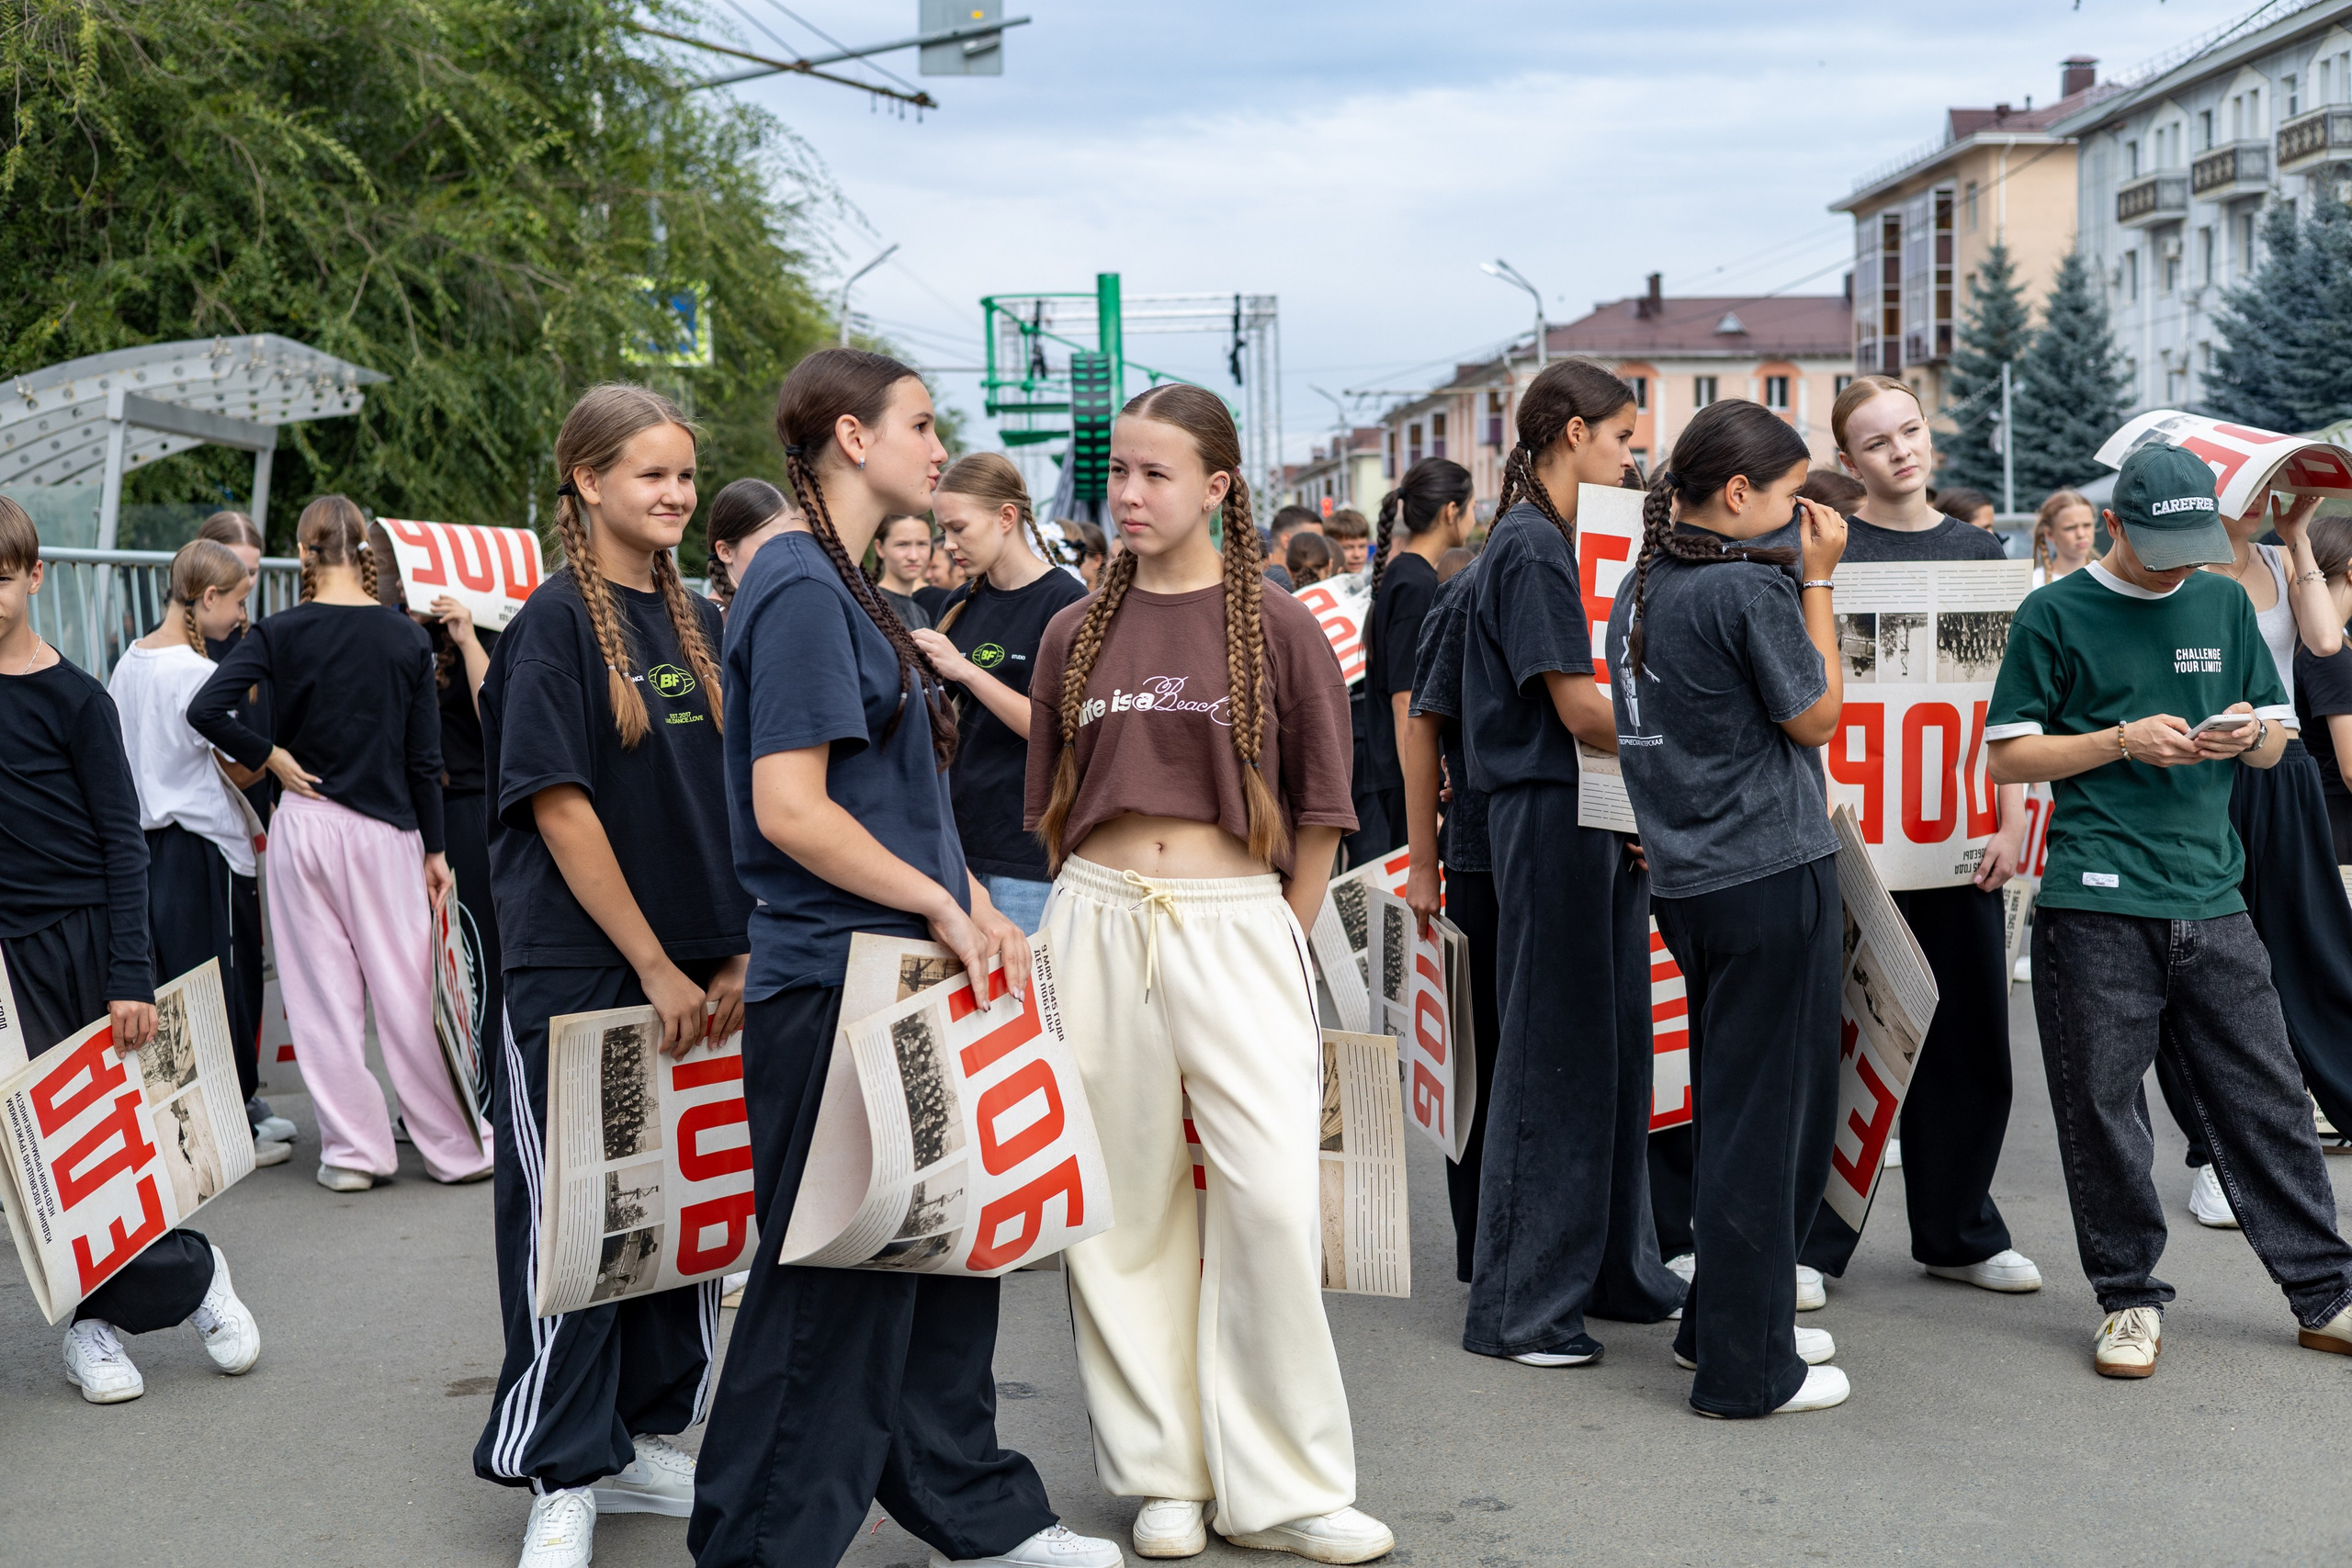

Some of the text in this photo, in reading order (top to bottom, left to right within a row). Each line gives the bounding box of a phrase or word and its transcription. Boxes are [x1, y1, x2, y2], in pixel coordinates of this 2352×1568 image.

[2152, 496, 2214, 516] CAREFREE
[661, 674, 680, 688] BF
[981, 649, 997, 660] BF
[2173, 660, 2222, 673] YOUR LIMITS
[2176, 649, 2222, 660] CHALLENGE
[1111, 689, 1133, 713] is
[1034, 950, 1055, 1032] ДЕНЬ ПОБЕДЫ
[1041, 944, 1065, 1042] 9 МАЯ 1945 ГОДА
[948, 966, 1084, 1271] ПОБ
[6, 1097, 52, 1245] ИЗДАНИЕ ПОСВЯЩЕНО ТРУЖЕНИКАМ
[15, 1090, 56, 1218] НЕФТЯНОЙ ПРОМЫШЛЕННОСТИ
[29, 1024, 167, 1299] ЕДА
